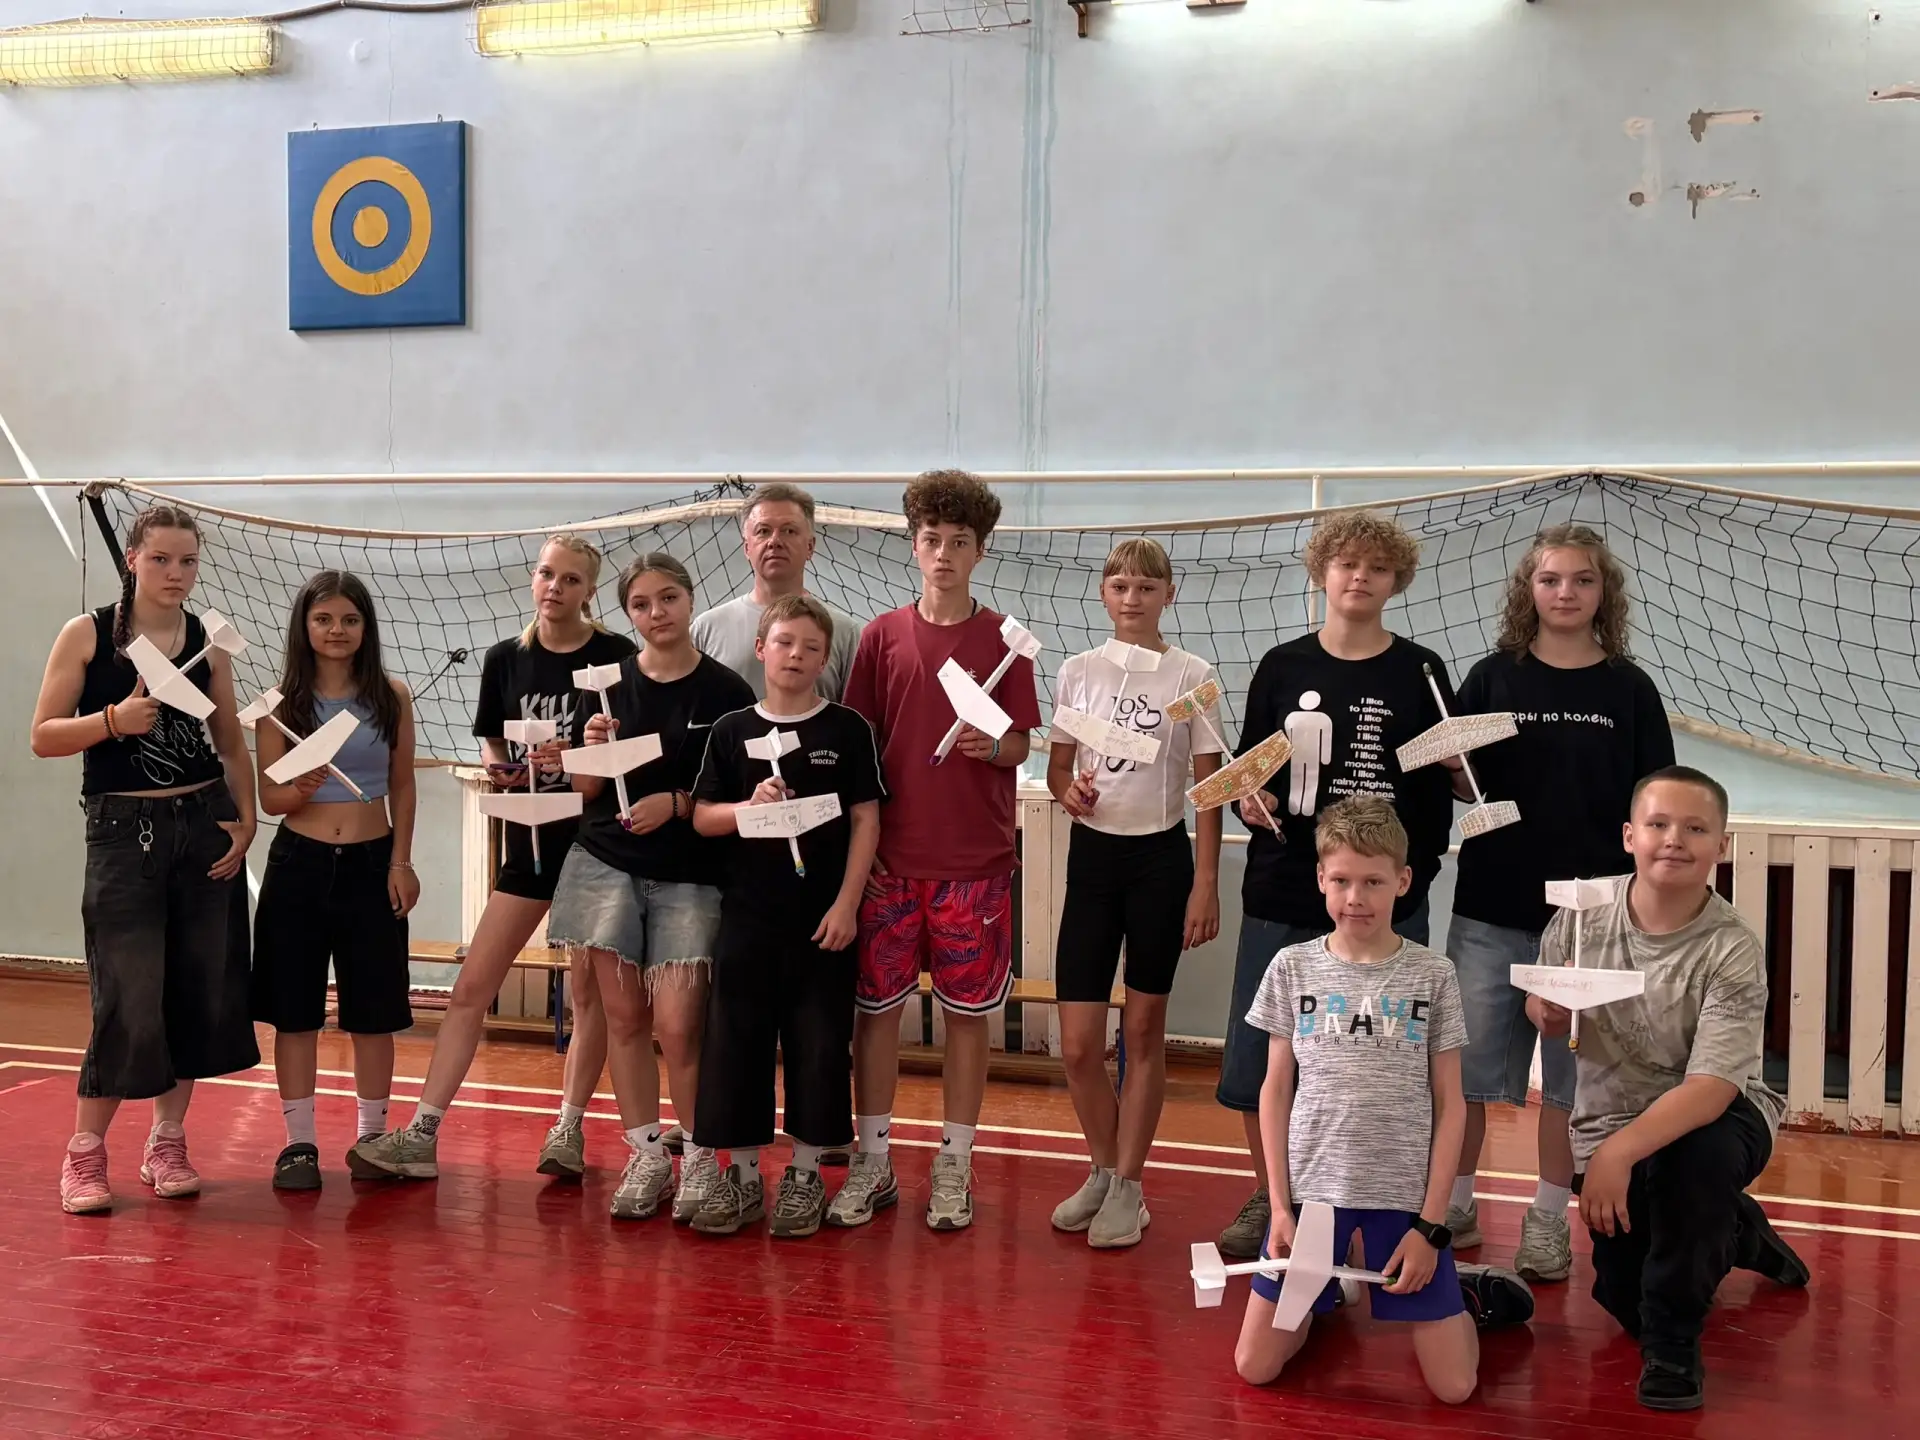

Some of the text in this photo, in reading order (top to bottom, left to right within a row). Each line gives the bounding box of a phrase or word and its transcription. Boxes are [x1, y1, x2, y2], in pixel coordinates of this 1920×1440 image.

[1360, 697, 1384, 706] I like
[1362, 706, 1393, 716] sleep,
[1364, 714, 1382, 723] like
[1542, 712, 1559, 723] по
[1563, 711, 1615, 729] колено
[1356, 724, 1383, 733] cats,
[1362, 733, 1380, 741] like
[1350, 742, 1384, 752] music,
[808, 750, 840, 760] TRUST THE
[1360, 751, 1378, 760] like
[1344, 760, 1386, 771] movies,
[1358, 770, 1376, 779] like
[1332, 778, 1394, 790] rainy nights,
[1333, 786, 1354, 796] love
[1301, 1036, 1420, 1052] FOREVER
